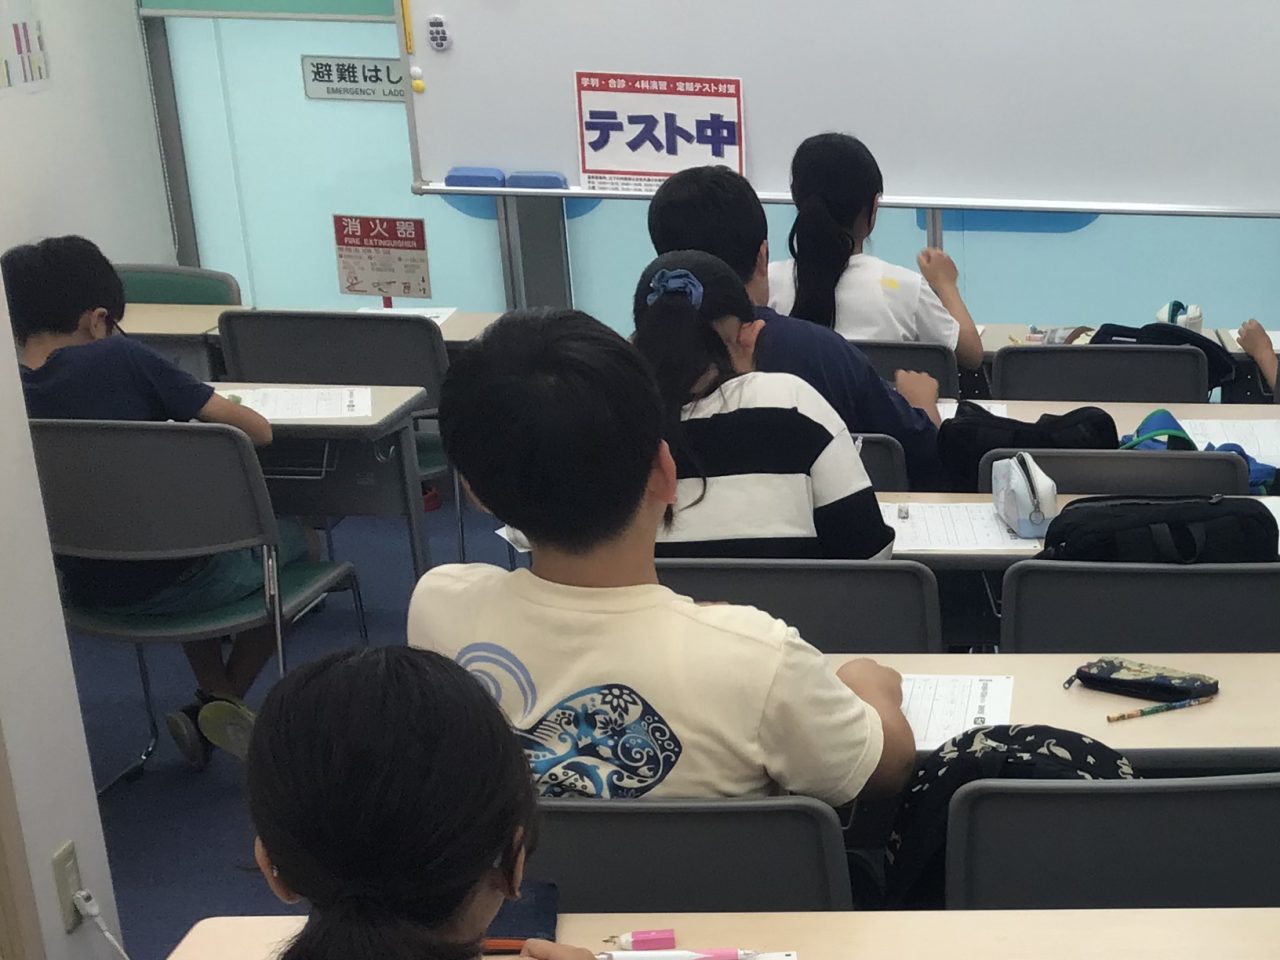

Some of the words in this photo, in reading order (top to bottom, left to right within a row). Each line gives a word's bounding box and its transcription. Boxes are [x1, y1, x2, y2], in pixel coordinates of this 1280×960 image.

[326, 86, 376, 95] EMERGENCY
[584, 110, 738, 158] テスト中
[342, 217, 415, 238] 消火器
